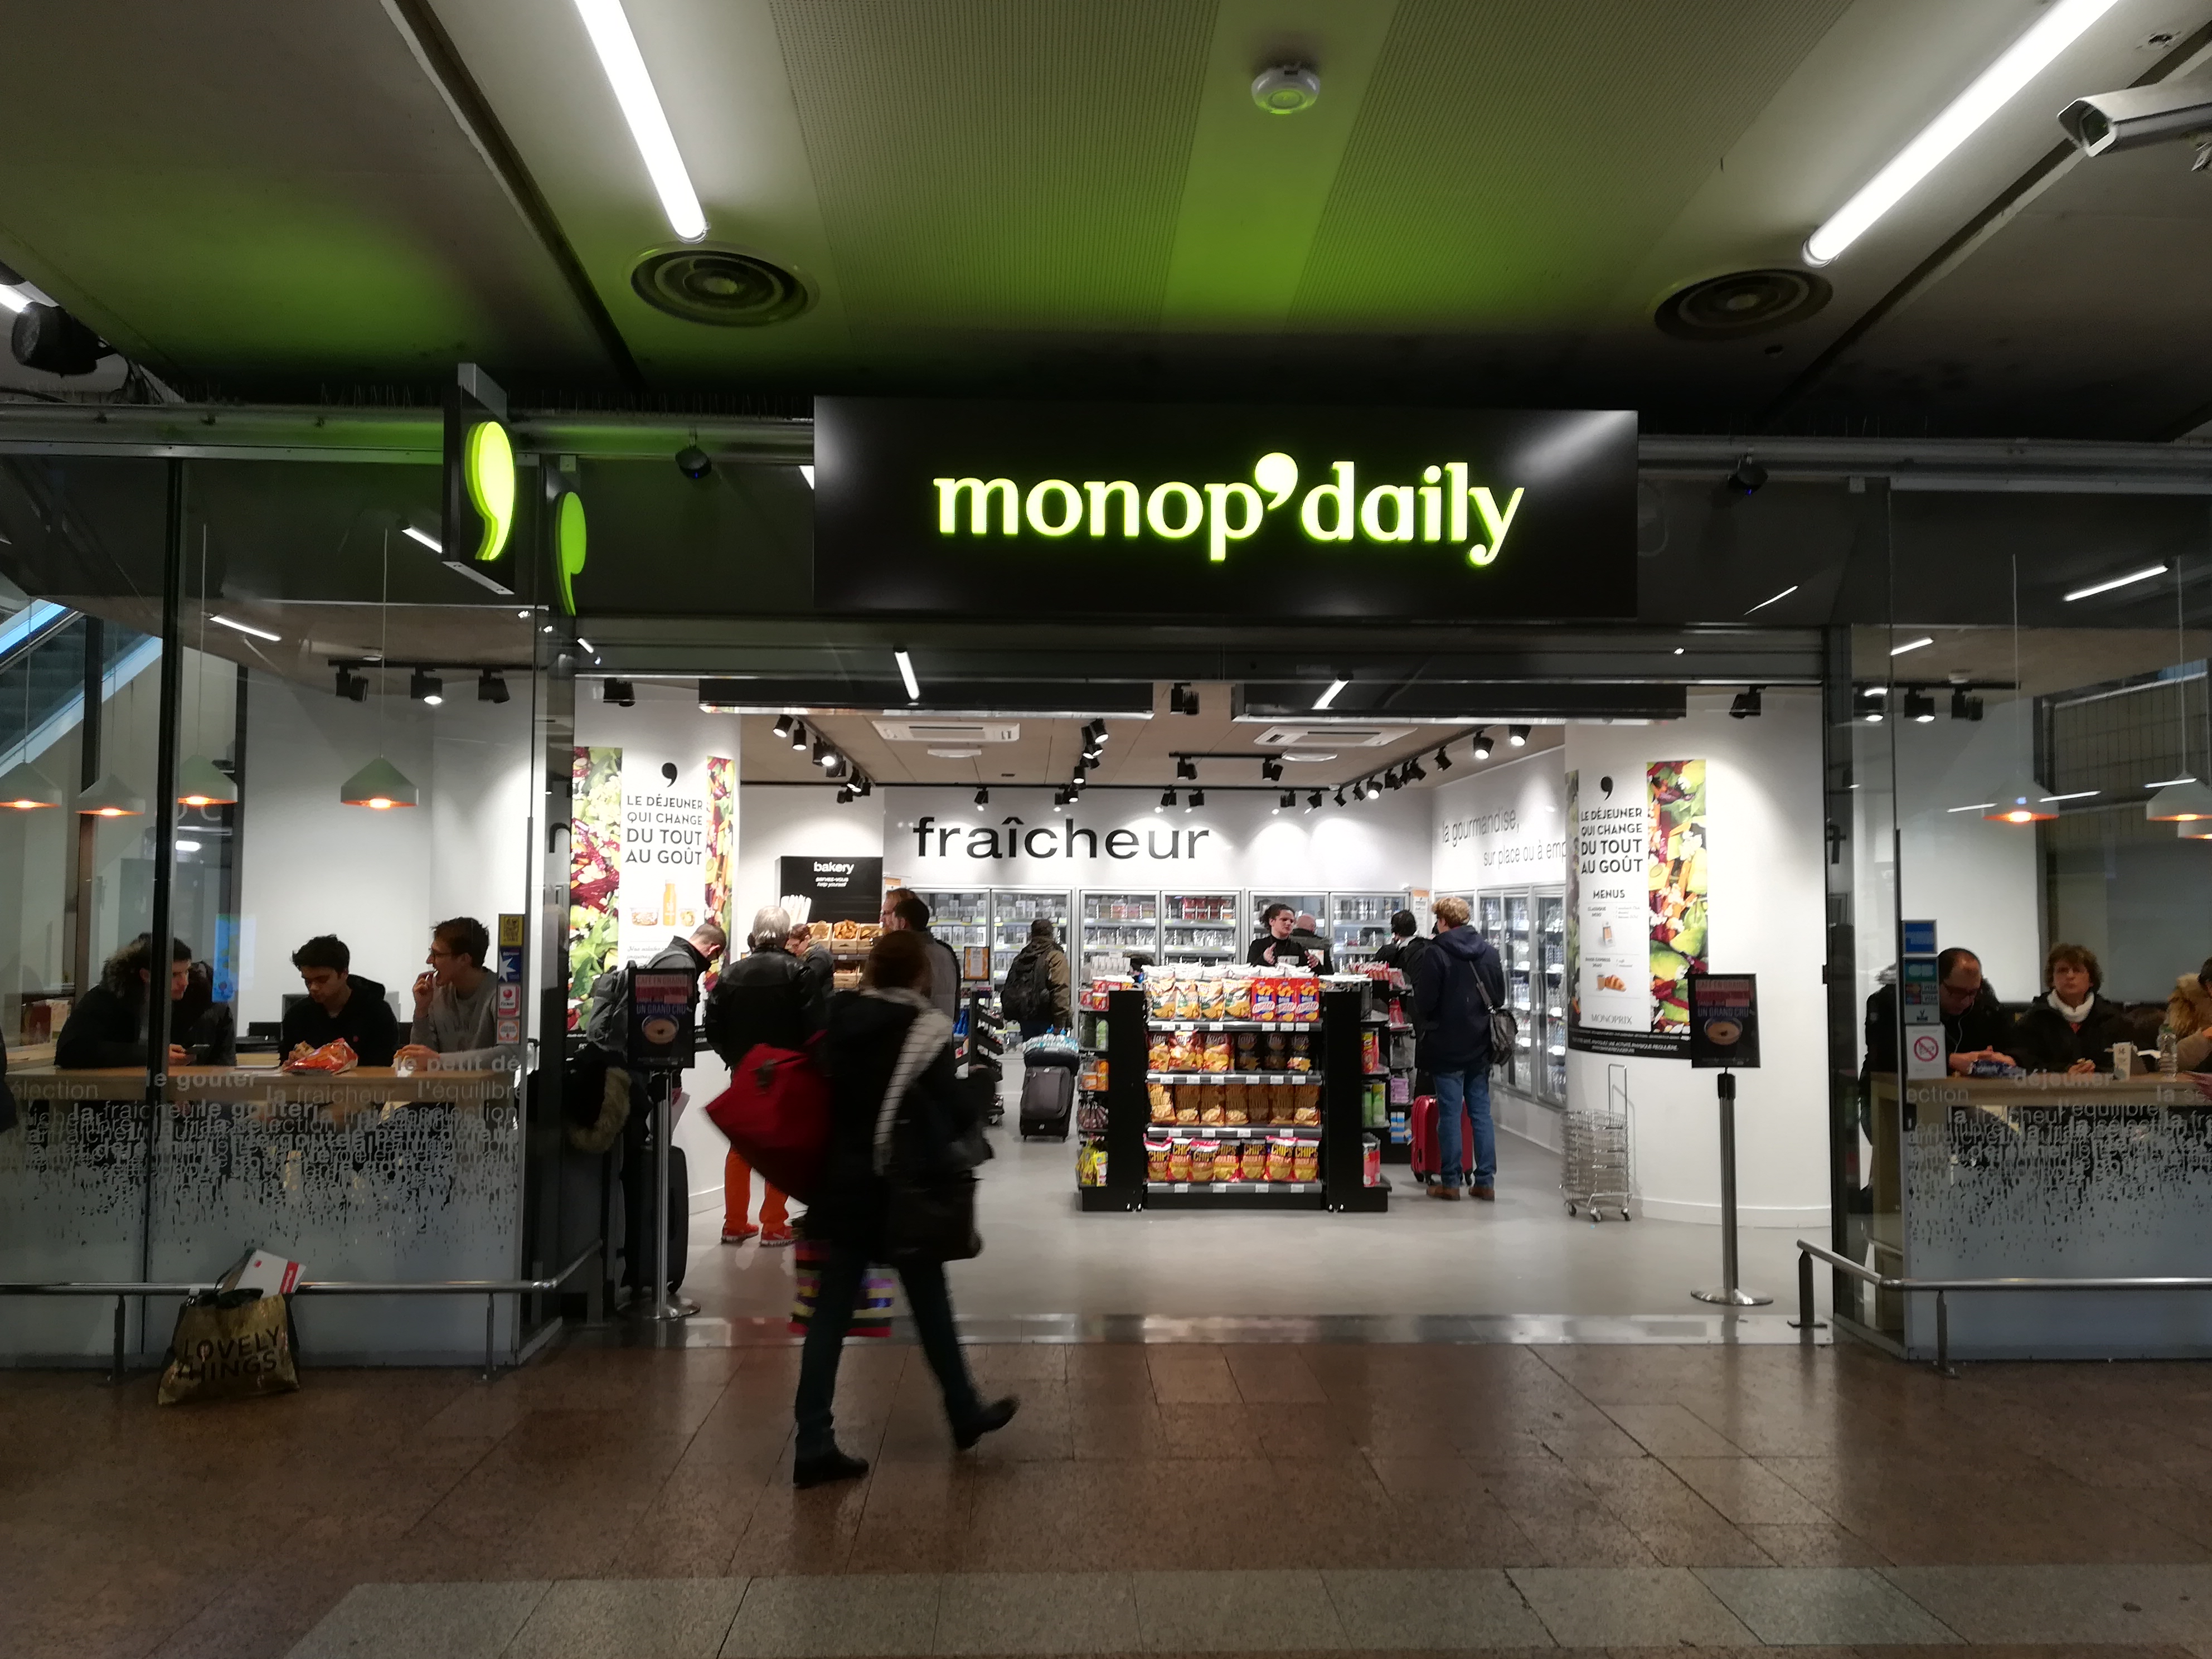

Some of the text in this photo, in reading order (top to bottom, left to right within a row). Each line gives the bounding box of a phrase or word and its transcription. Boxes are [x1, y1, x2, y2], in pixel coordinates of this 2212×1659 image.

[627, 794, 702, 809] LE DÉJEUNER
[627, 812, 702, 825] QUI CHANGE
[1581, 806, 1642, 822] LE DÉJEUNER
[627, 828, 702, 845] DU TOUT
[913, 816, 1210, 860] fraîcheur
[1582, 823, 1643, 838] QUI CHANGE
[1483, 851, 1496, 866] sur
[1498, 845, 1520, 869] place
[1523, 845, 1534, 862] ou
[1537, 840, 1543, 860] à
[1582, 838, 1642, 856] DU TOUT
[625, 847, 702, 865] AU GOÛT
[813, 861, 855, 874] bakery
[1581, 855, 1643, 874] AU GOÛT
[1593, 889, 1626, 899] MENUS
[637, 1004, 646, 1015] UN
[1697, 1007, 1707, 1017] UN
[1591, 1013, 1633, 1025] MONOPRIX
[427, 1054, 483, 1072] petit
[491, 1055, 521, 1072] dé
[11, 1079, 99, 1100] élection
[183, 1325, 279, 1360] LOVELY
